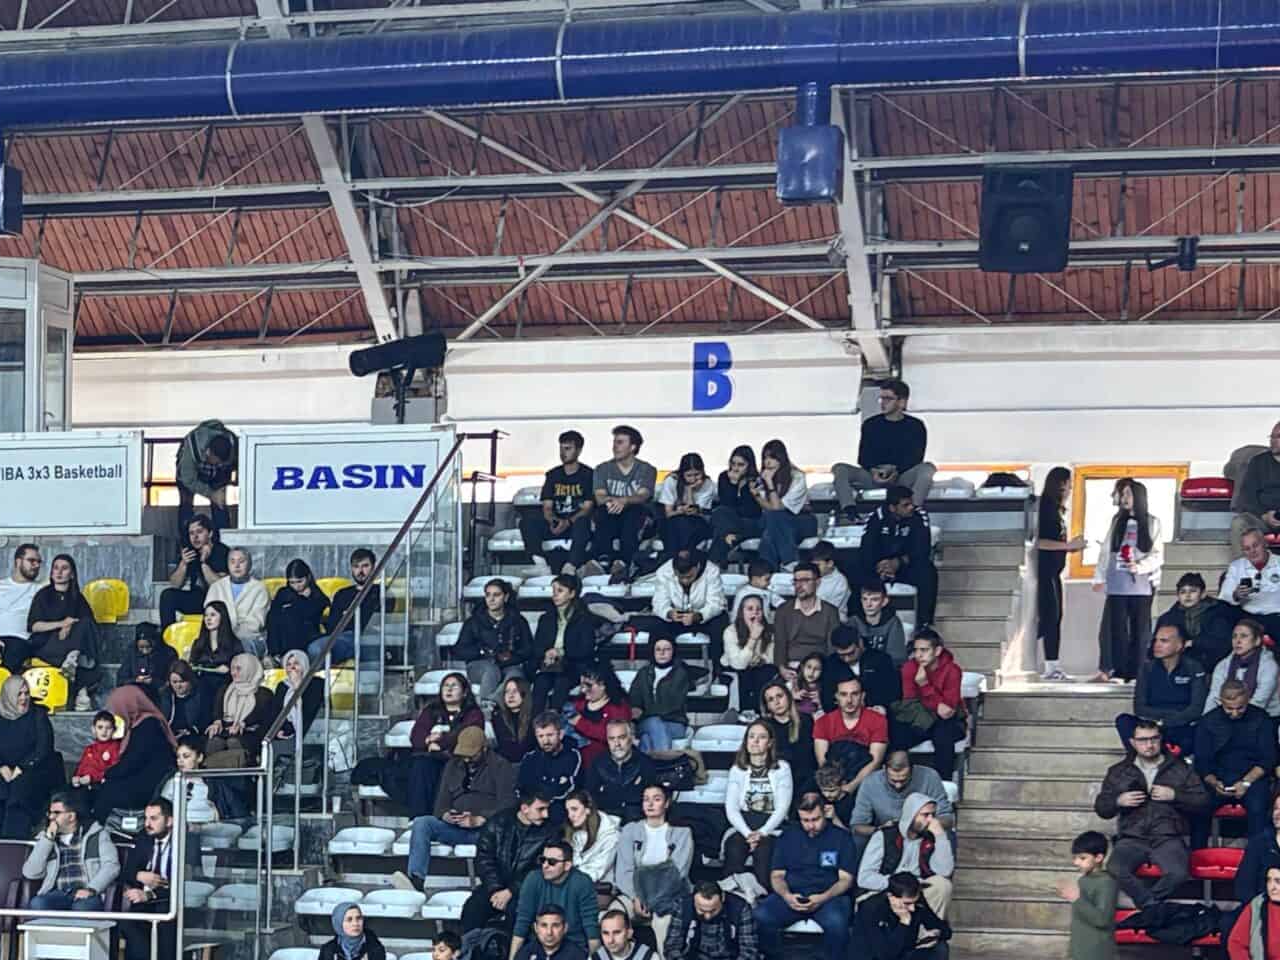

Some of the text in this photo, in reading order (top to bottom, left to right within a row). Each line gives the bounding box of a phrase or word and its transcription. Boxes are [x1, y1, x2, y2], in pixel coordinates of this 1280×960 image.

[692, 342, 732, 410] B
[27, 466, 50, 480] 3x3
[54, 464, 122, 479] Basketball
[271, 464, 426, 490] BASIN
